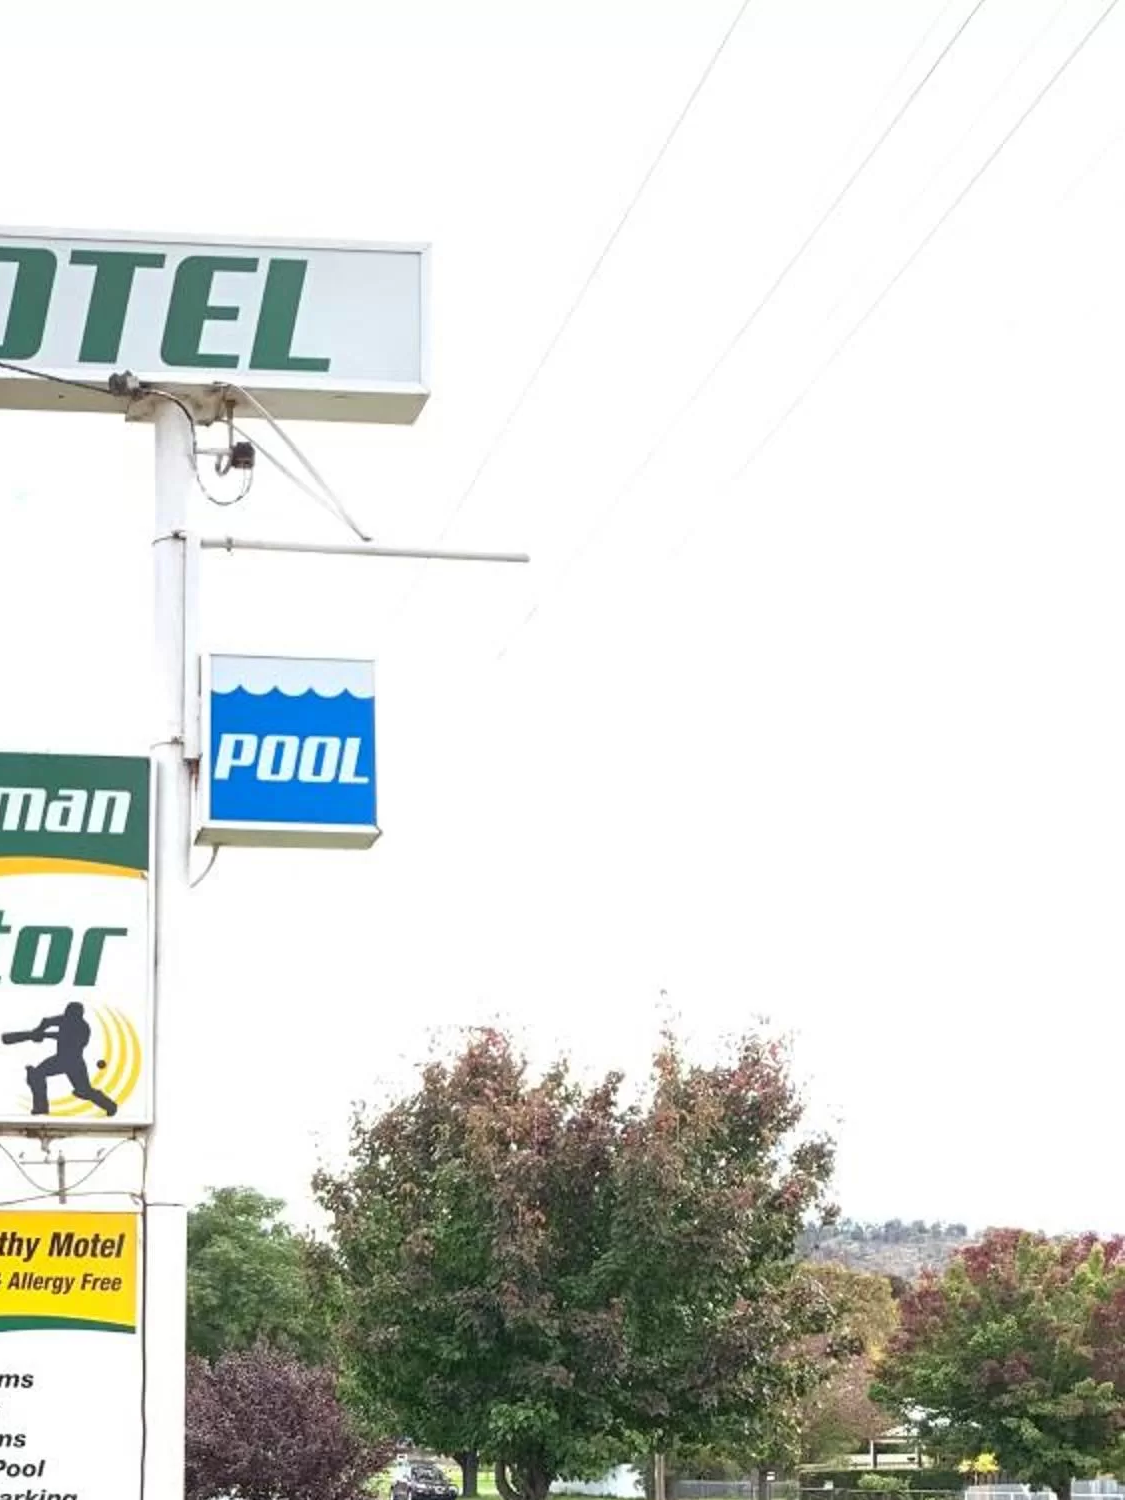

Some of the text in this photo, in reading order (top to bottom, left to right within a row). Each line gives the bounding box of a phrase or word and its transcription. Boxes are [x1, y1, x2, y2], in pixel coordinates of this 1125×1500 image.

[214, 733, 369, 784] POOL
[48, 1232, 125, 1258] Motel
[8, 1273, 74, 1294] Allergy
[81, 1274, 122, 1292] Free
